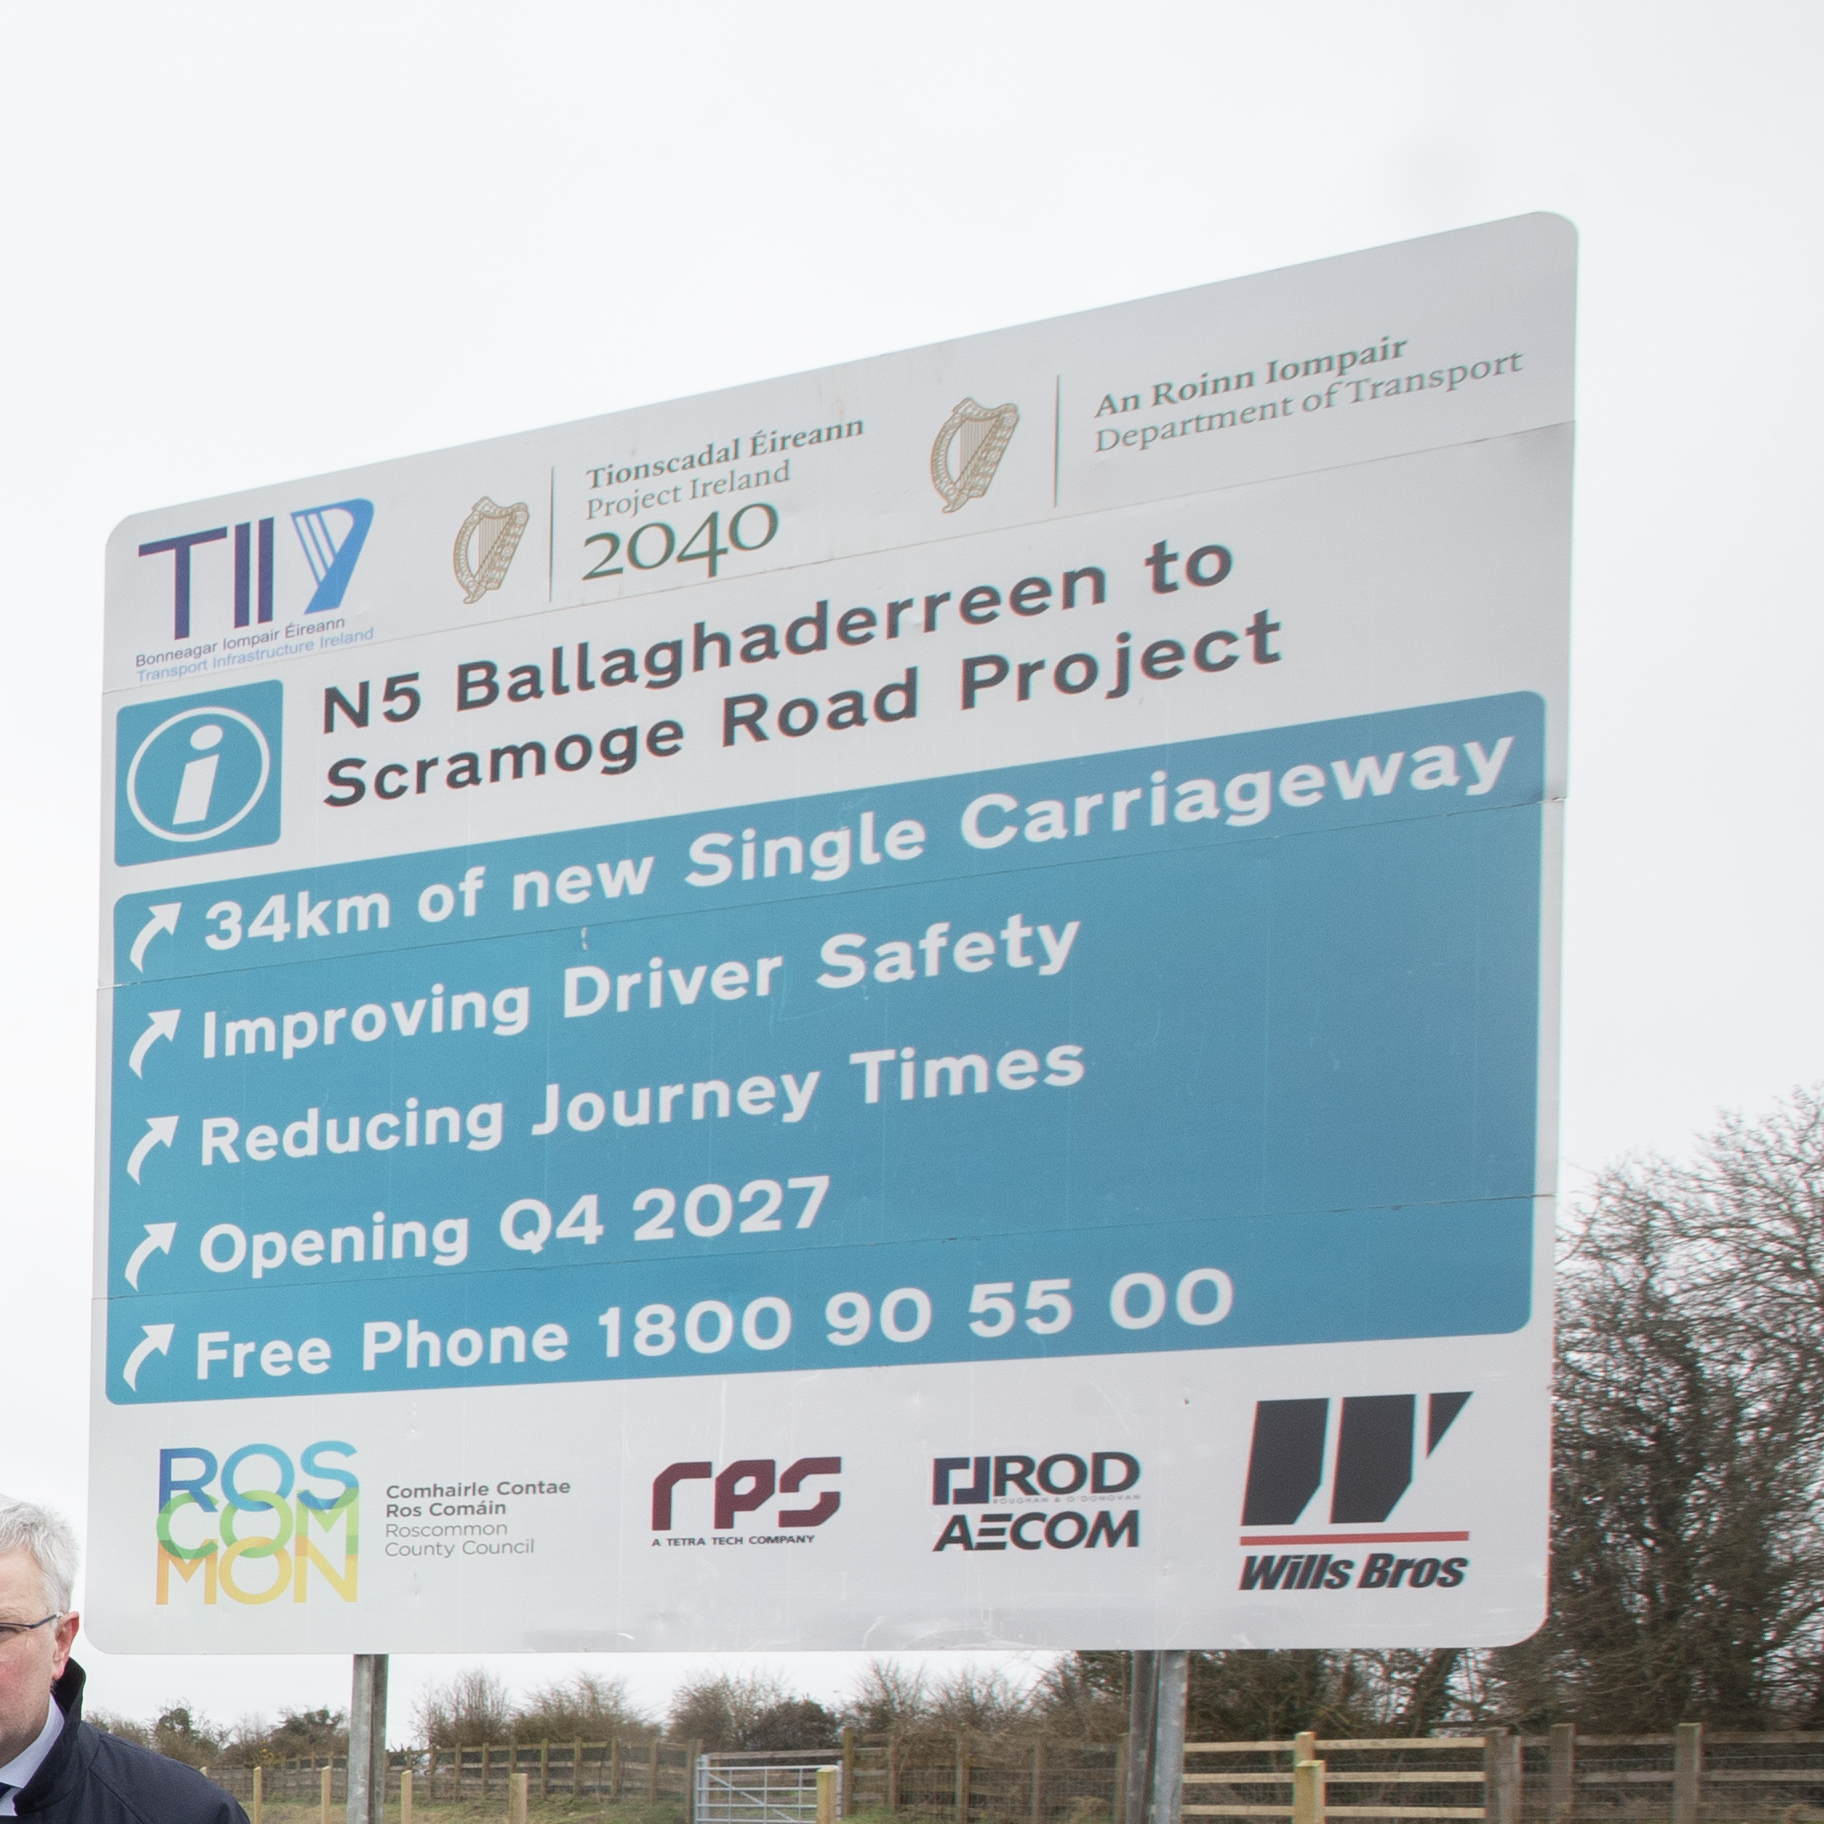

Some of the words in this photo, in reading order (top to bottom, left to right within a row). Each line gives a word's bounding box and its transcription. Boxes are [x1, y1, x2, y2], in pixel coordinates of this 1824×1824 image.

[1095, 393, 1141, 419] An
[1151, 371, 1254, 406] Roinn
[1266, 336, 1409, 382] Iompair
[1095, 399, 1294, 453] Department
[1301, 380, 1345, 413] of
[1346, 350, 1524, 403] Transport
[586, 438, 740, 489] Tionscadal
[749, 419, 864, 457] Éireann
[586, 484, 682, 520] Project
[689, 458, 791, 500] Ireland
[581, 502, 779, 581] 2040
[136, 642, 218, 667] Bonneagar
[223, 628, 280, 652] Iompair
[285, 618, 345, 638] Éireann
[137, 660, 208, 683] Transport
[213, 641, 315, 669] Infrastructure
[320, 627, 374, 648] Ireland
[323, 672, 421, 734] N5
[456, 562, 1107, 705] Ballaghaderreen
[1145, 538, 1235, 596] to
[323, 714, 687, 808] Scramoge
[720, 666, 922, 748] Road
[959, 607, 1283, 711] Project
[203, 880, 394, 954] 34km
[417, 866, 487, 925] of
[511, 845, 656, 910] new
[683, 812, 930, 892] Single
[959, 730, 1519, 851] Carriageway
[202, 981, 531, 1060] Improving
[563, 947, 784, 1020] Driver
[815, 912, 1081, 990] Safety
[201, 1090, 505, 1166] Reducing
[532, 1067, 821, 1138] Journey
[849, 1043, 1086, 1106] Times
[199, 1210, 470, 1278] Opening
[498, 1193, 605, 1254] Q4
[633, 1174, 831, 1241] 2027
[196, 1327, 333, 1381] Free
[362, 1311, 570, 1370] Phone
[597, 1294, 792, 1360] 1800
[825, 1285, 933, 1344] 90
[968, 1277, 1074, 1337] 55
[1110, 1268, 1235, 1330] 00
[158, 1440, 360, 1514] ROS
[385, 1482, 491, 1499] Comhairle
[495, 1479, 572, 1497] Contae
[386, 1503, 424, 1518] Ros
[428, 1499, 507, 1517] Comáin
[991, 1451, 1141, 1497] ROD
[156, 1487, 360, 1560] COM
[384, 1540, 455, 1559] County
[459, 1538, 535, 1556] Council
[385, 1520, 508, 1538] Roscommon
[652, 1537, 661, 1547] A
[666, 1537, 707, 1547] TETRA
[712, 1536, 744, 1546] TECH
[748, 1535, 815, 1545] COMPANY
[932, 1509, 1140, 1552] AECOM
[156, 1534, 358, 1605] MON
[1238, 1554, 1354, 1591] Wills
[1357, 1553, 1469, 1588] Bros
